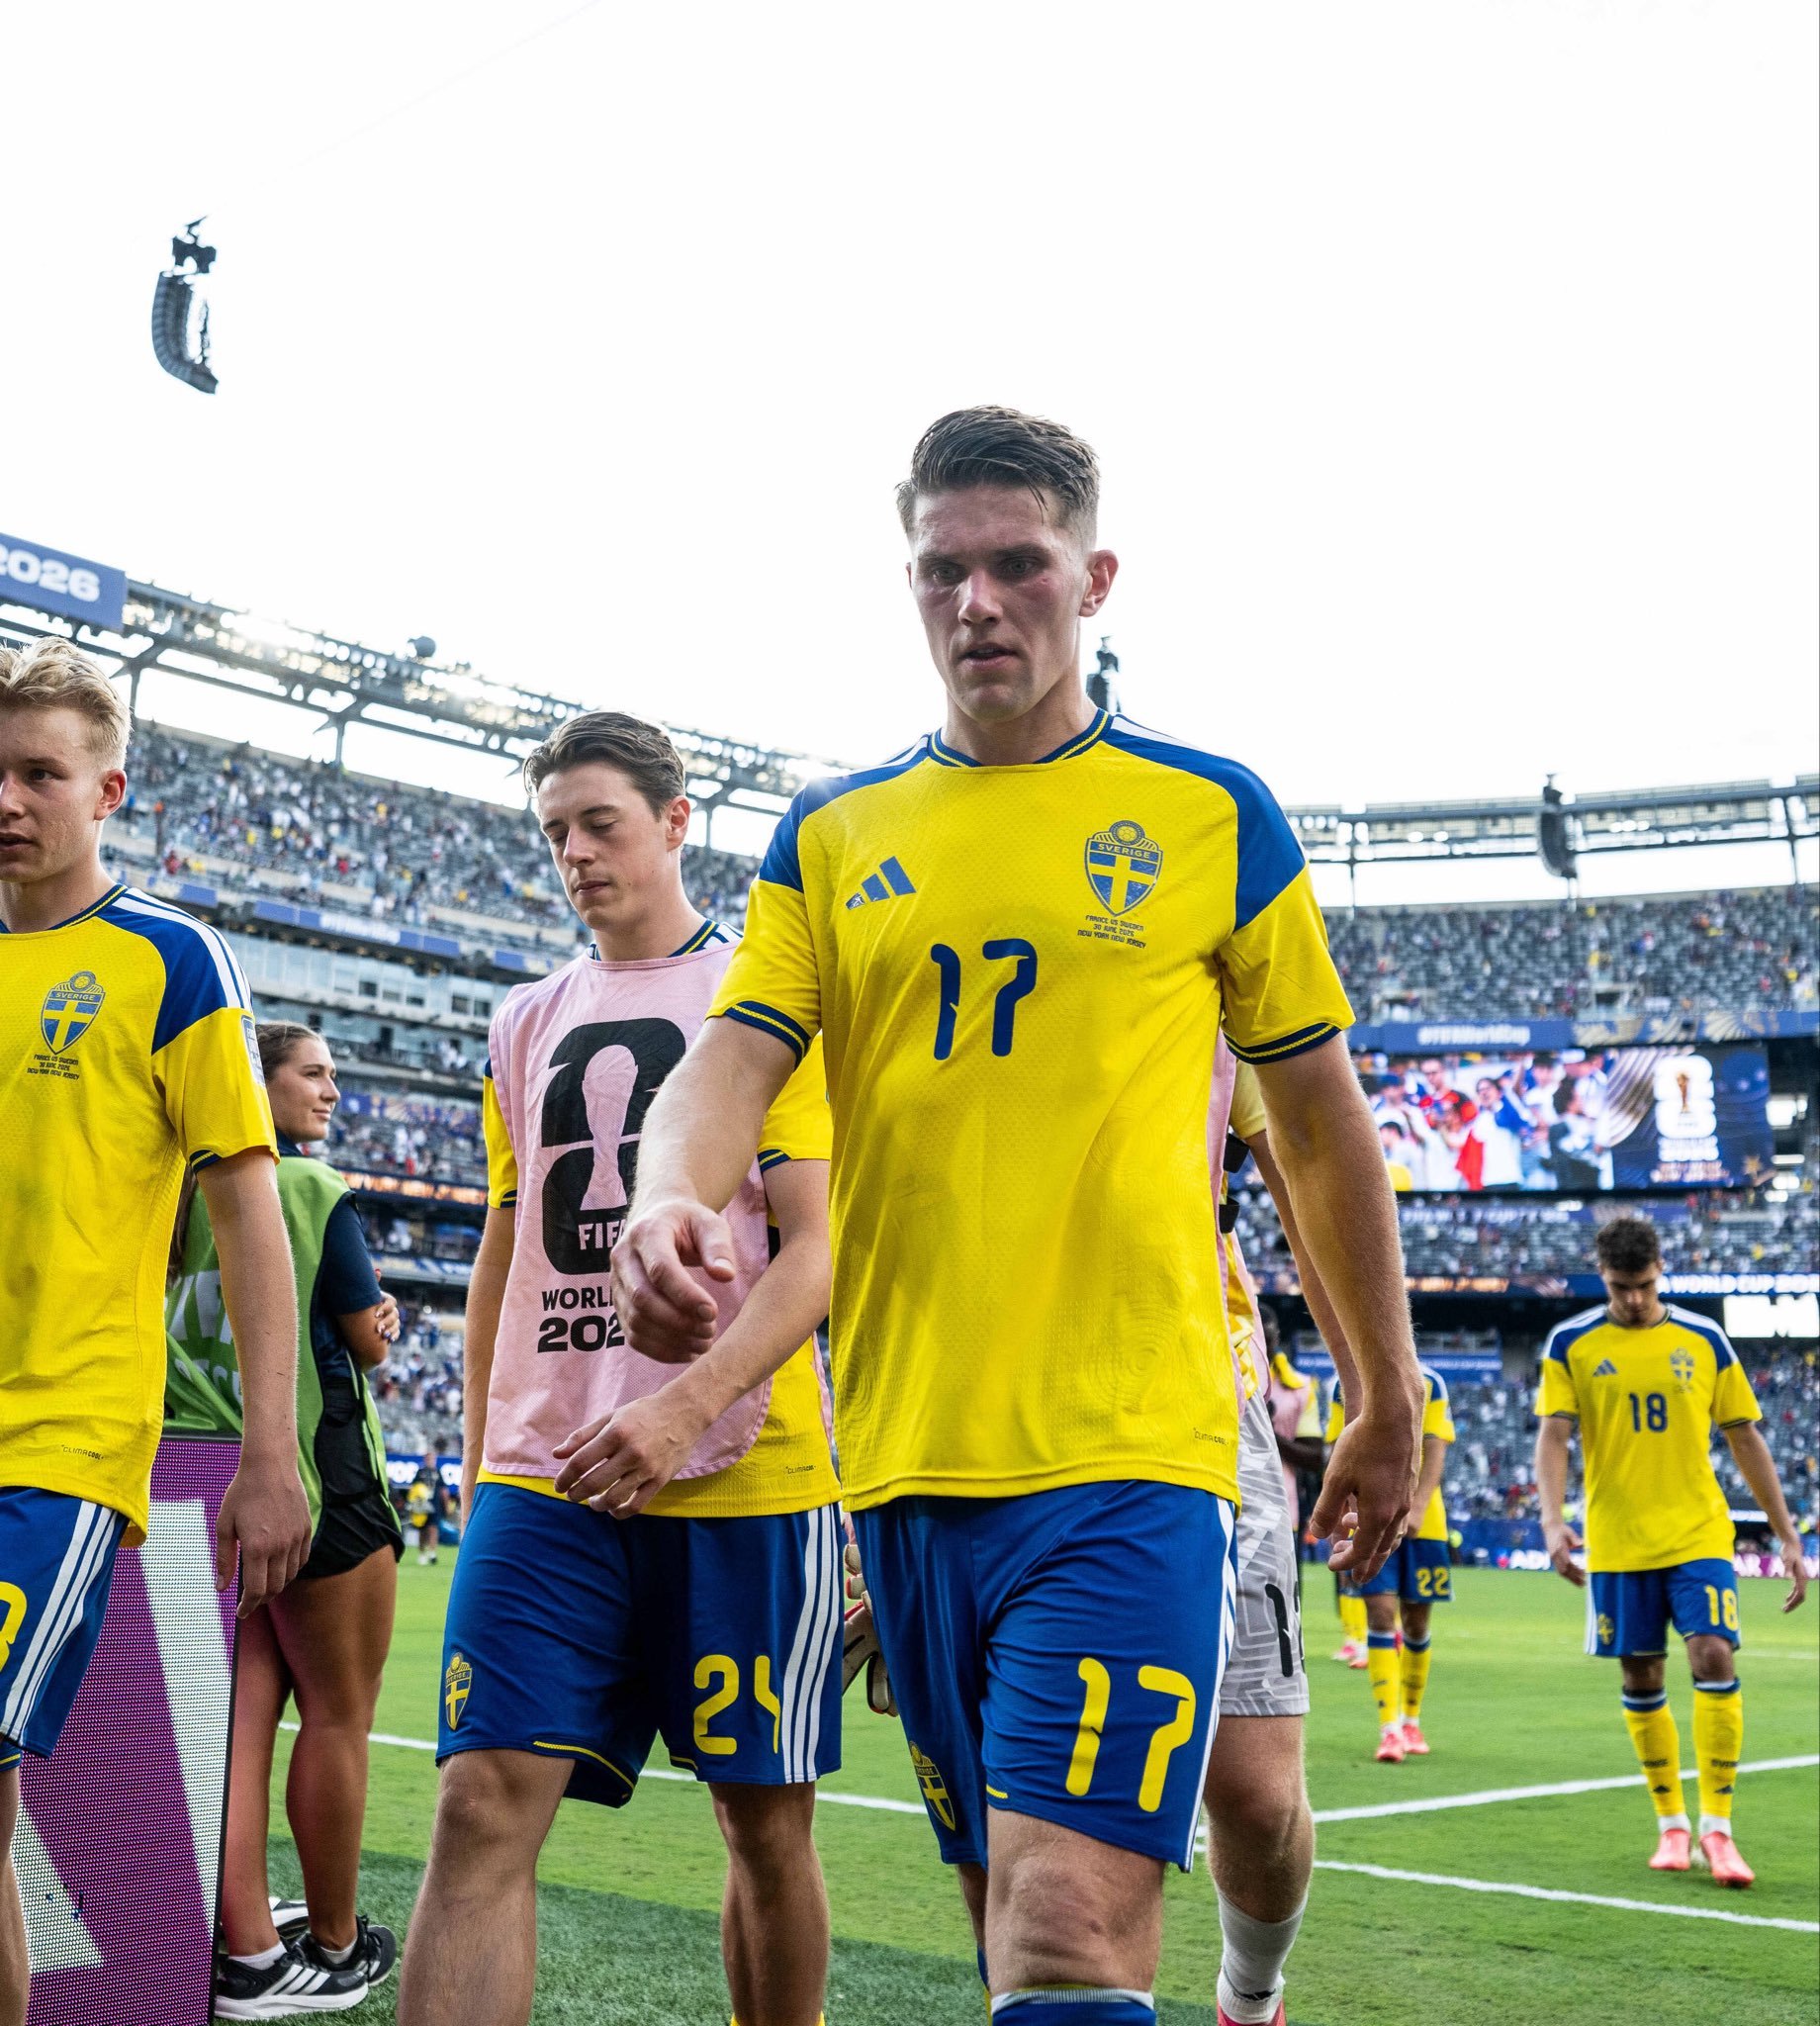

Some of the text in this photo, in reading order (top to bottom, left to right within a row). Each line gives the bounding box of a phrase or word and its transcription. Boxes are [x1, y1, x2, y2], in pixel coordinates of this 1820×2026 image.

[1098, 843, 1150, 859] SVERIGE
[1086, 915, 1108, 924] FRANCE
[1120, 920, 1143, 931] SWEDEN
[1127, 938, 1145, 948] JERSEY
[55, 991, 95, 1001] SVERIGE
[930, 938, 1038, 1061] 17
[579, 1219, 625, 1250] FIF
[542, 1286, 613, 1312] WORL
[537, 1312, 625, 1353] 202
[1628, 1392, 1669, 1433] 18
[1416, 1567, 1450, 1597] 22
[1704, 1585, 1739, 1631] 18
[693, 1654, 780, 1755] 24
[1065, 1657, 1197, 1812] 17
